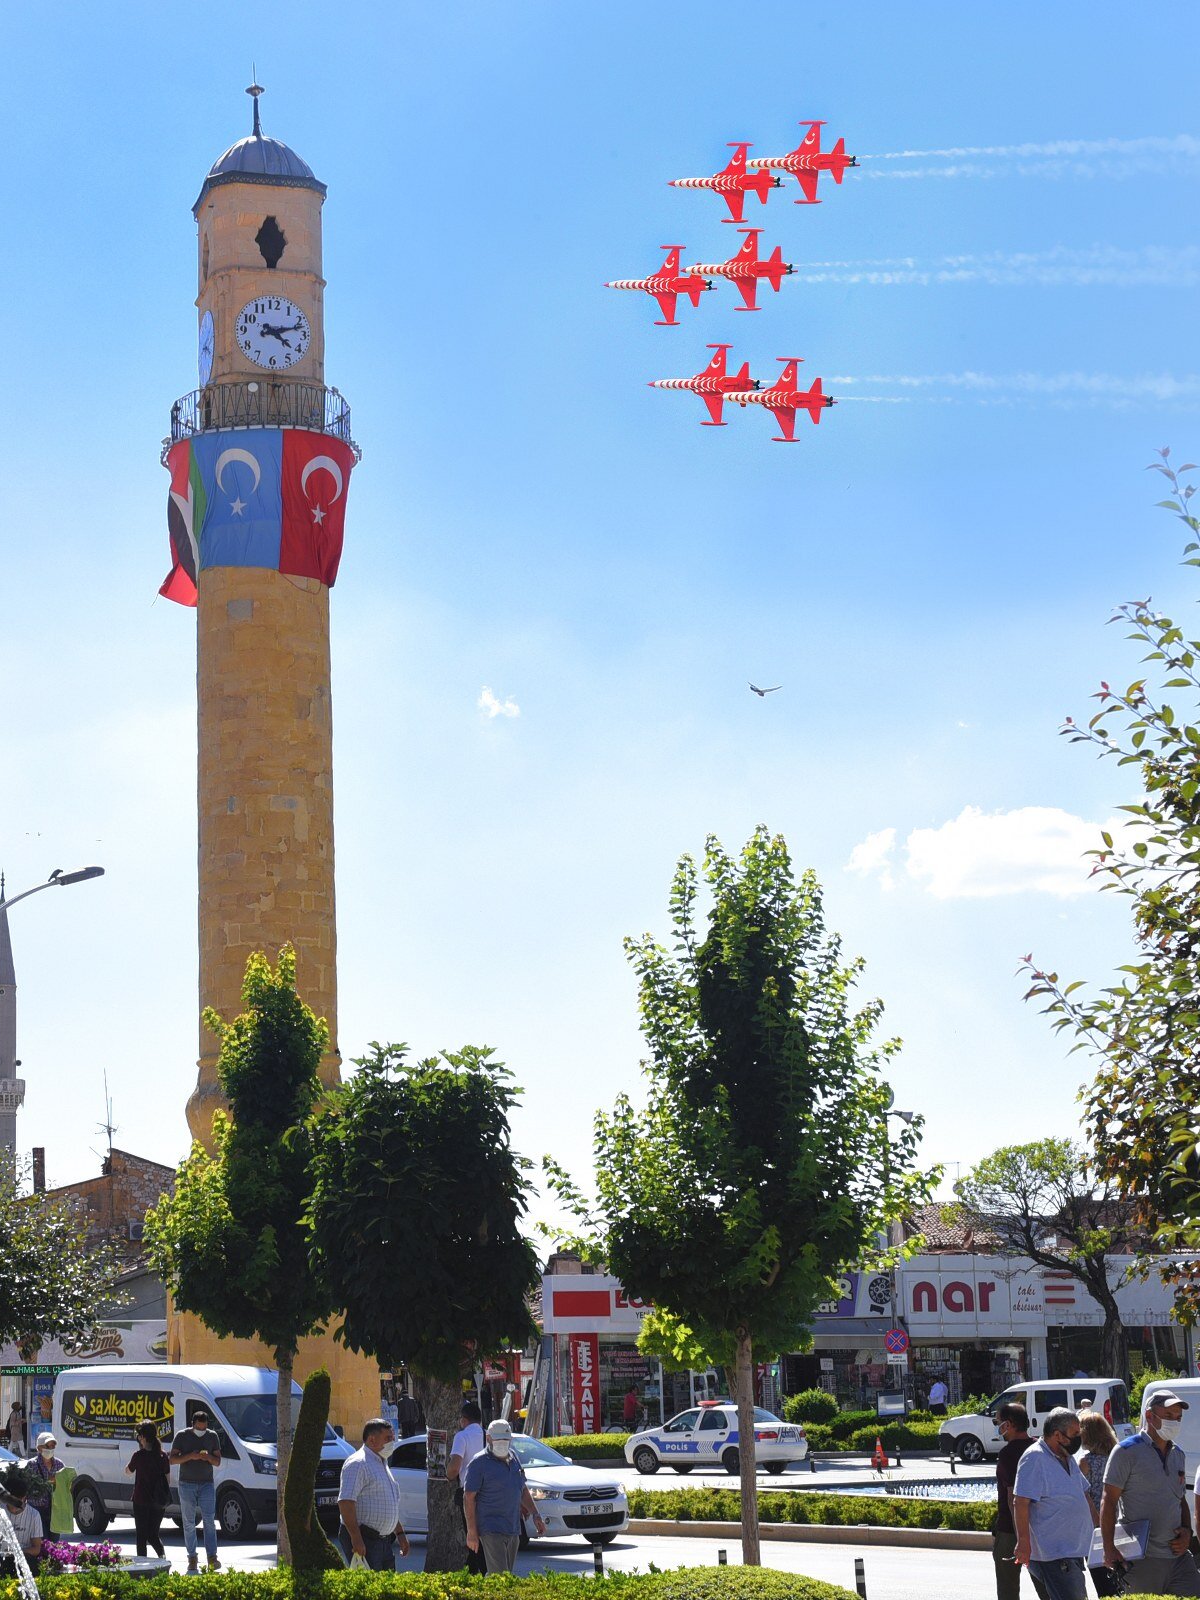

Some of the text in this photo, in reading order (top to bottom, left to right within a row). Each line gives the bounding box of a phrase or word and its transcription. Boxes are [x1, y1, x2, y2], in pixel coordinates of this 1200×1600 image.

[254, 303, 266, 314] 11
[267, 300, 281, 310] 12
[286, 306, 291, 316] 1
[244, 313, 256, 324] 10
[296, 315, 302, 326] 2
[240, 325, 247, 335] 9
[300, 330, 307, 341] 3
[244, 340, 251, 350] 8
[294, 343, 302, 354] 4
[254, 350, 261, 361] 7
[269, 355, 276, 366] 6
[285, 353, 291, 363] 5
[913, 1281, 996, 1312] nar
[665, 1443, 688, 1451] POLİS
